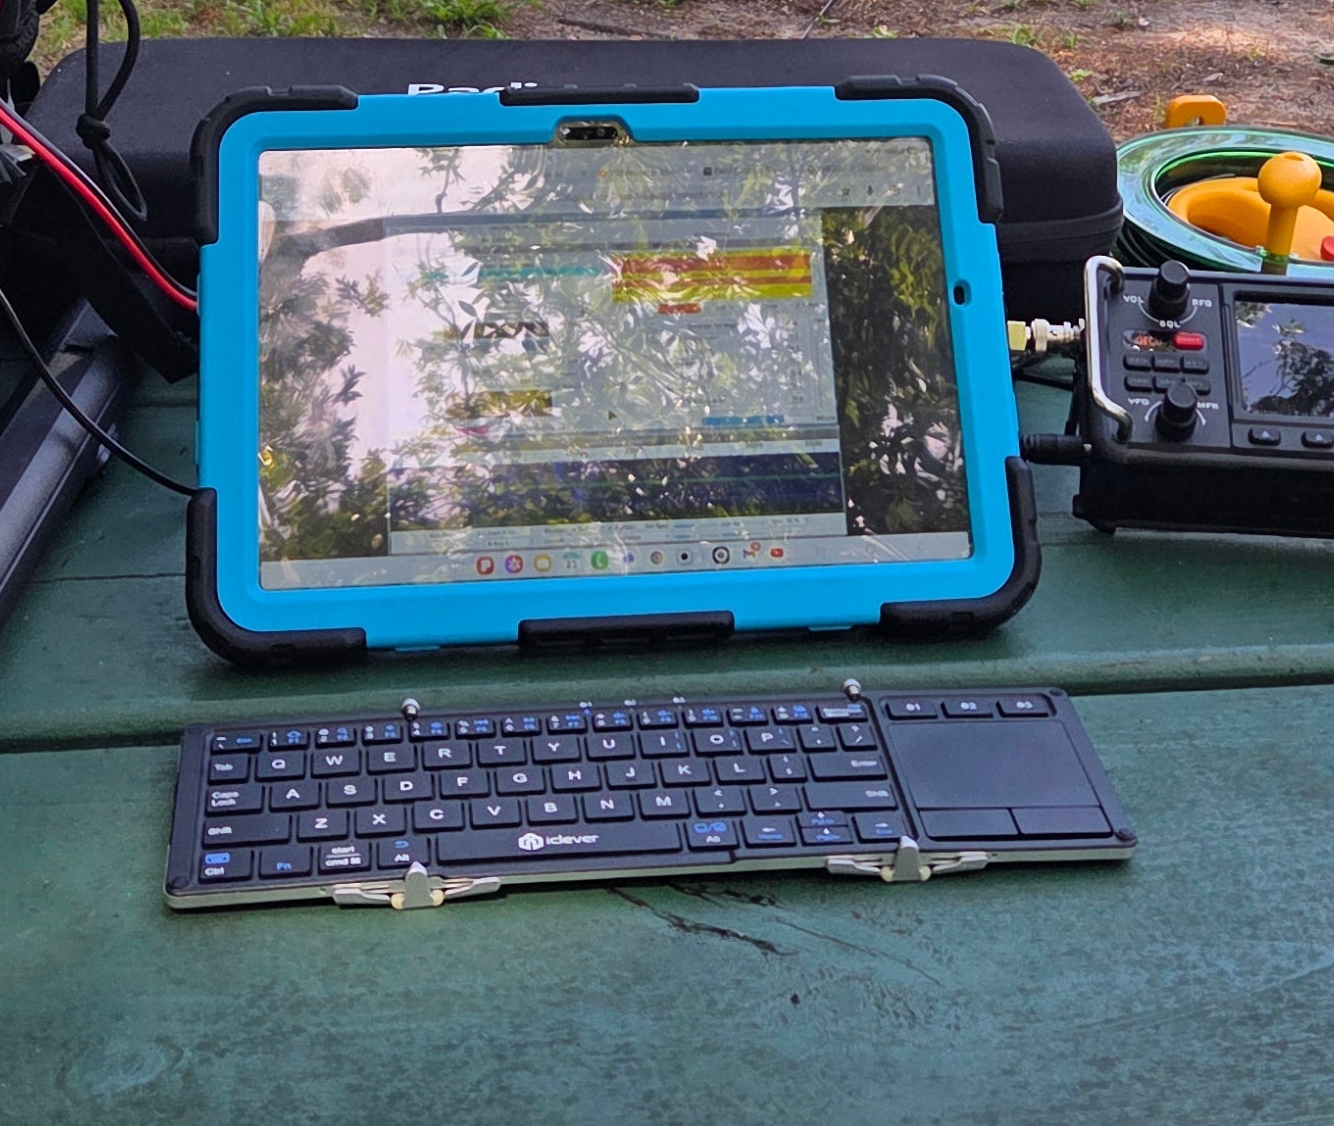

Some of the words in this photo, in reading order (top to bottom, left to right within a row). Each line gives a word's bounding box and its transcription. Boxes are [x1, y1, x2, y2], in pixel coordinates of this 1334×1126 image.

[1123, 294, 1144, 304] VOL
[709, 734, 724, 745] O
[760, 732, 774, 743] P
[547, 742, 560, 752] Y
[602, 739, 616, 749] U
[437, 748, 452, 759] R
[494, 745, 507, 755] T
[325, 754, 344, 766] W
[383, 751, 396, 763] E
[271, 758, 286, 769] Q
[733, 762, 746, 773] L
[625, 766, 636, 778] J
[677, 764, 692, 775] K
[567, 770, 582, 781] H
[399, 780, 414, 791] D
[456, 776, 469, 787] F
[285, 788, 301, 799] A
[343, 784, 357, 796] S
[600, 798, 615, 810] N
[655, 795, 672, 807] M
[487, 805, 501, 816] V
[543, 802, 558, 813] B
[372, 813, 387, 825] X
[429, 808, 444, 820] C
[314, 817, 328, 829] Z
